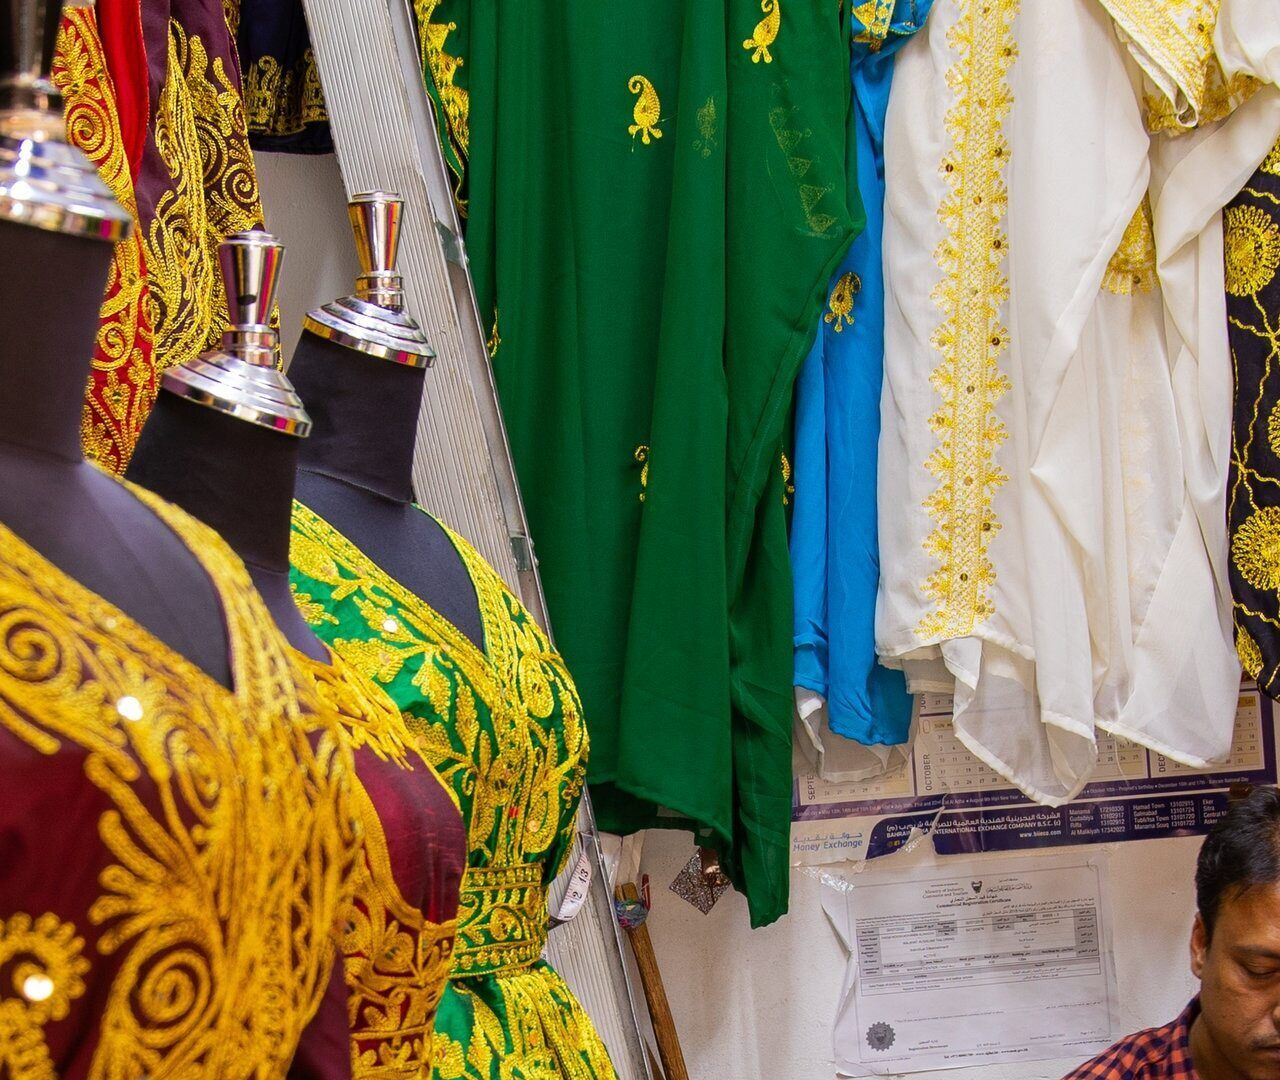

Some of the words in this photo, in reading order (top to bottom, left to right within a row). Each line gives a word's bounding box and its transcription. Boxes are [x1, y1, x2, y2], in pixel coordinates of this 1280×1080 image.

[923, 753, 933, 791] OCTOBER
[806, 774, 816, 800] SEPTE
[1151, 801, 1166, 809] Town
[934, 827, 977, 835] NTERNATIONAL
[1008, 821, 1036, 830] COMPANY
[794, 843, 820, 852] Money
[823, 839, 863, 850] Exchange
[578, 868, 589, 883] 13
